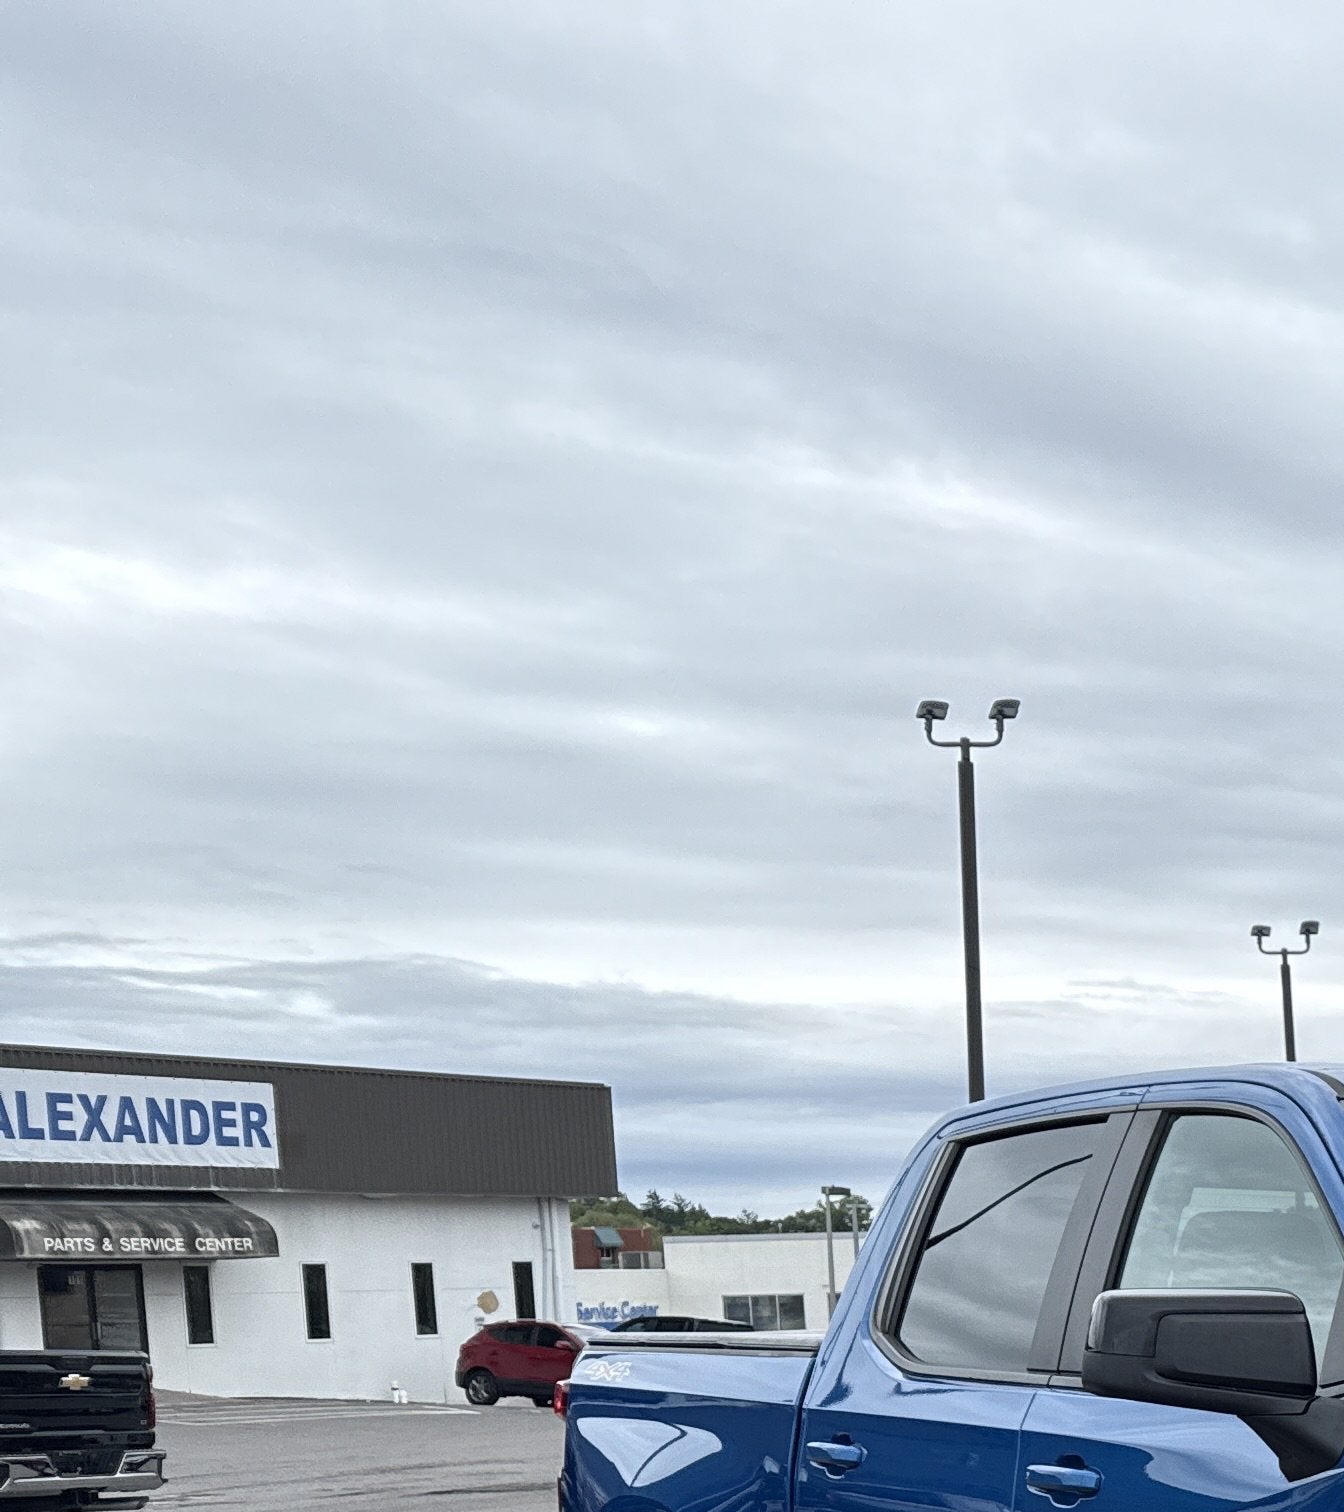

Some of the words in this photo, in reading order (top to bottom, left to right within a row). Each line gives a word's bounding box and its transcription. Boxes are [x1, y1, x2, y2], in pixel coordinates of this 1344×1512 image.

[43, 1237, 95, 1251] PARTS
[102, 1237, 113, 1251] &
[120, 1237, 186, 1251] SERVICE
[194, 1237, 254, 1251] CENTER
[576, 1302, 618, 1321] Service
